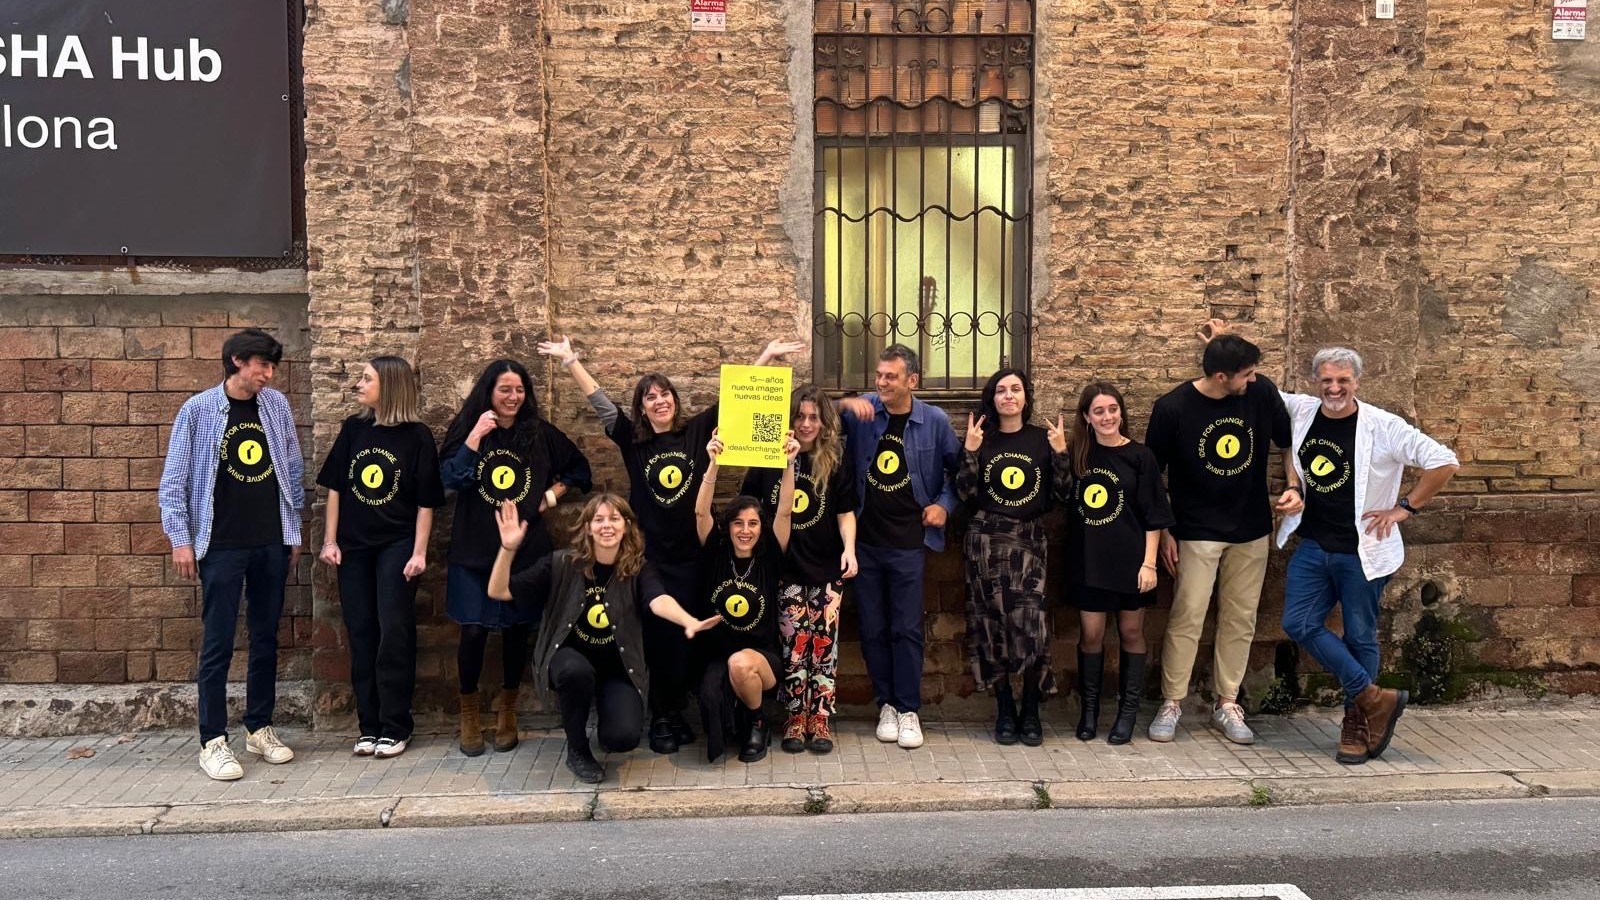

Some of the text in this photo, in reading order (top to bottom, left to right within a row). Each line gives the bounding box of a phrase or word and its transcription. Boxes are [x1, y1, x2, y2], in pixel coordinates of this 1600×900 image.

[1554, 8, 1585, 16] Alarma
[0, 34, 222, 82] HA Hub
[3, 104, 118, 150] lona
[734, 393, 760, 401] nuevas
[756, 386, 784, 394] imagen
[225, 426, 240, 439] FOR
[1198, 438, 1206, 458] IDEAS
[1202, 423, 1216, 438] FOR
[356, 449, 370, 460] FOR
[727, 444, 780, 454] ideasforchange
[984, 464, 993, 483] IDEAS
[990, 454, 1004, 464] FOR
[770, 484, 780, 505] IDEAS
[1084, 489, 1125, 526] TRANSFORMATIVE
